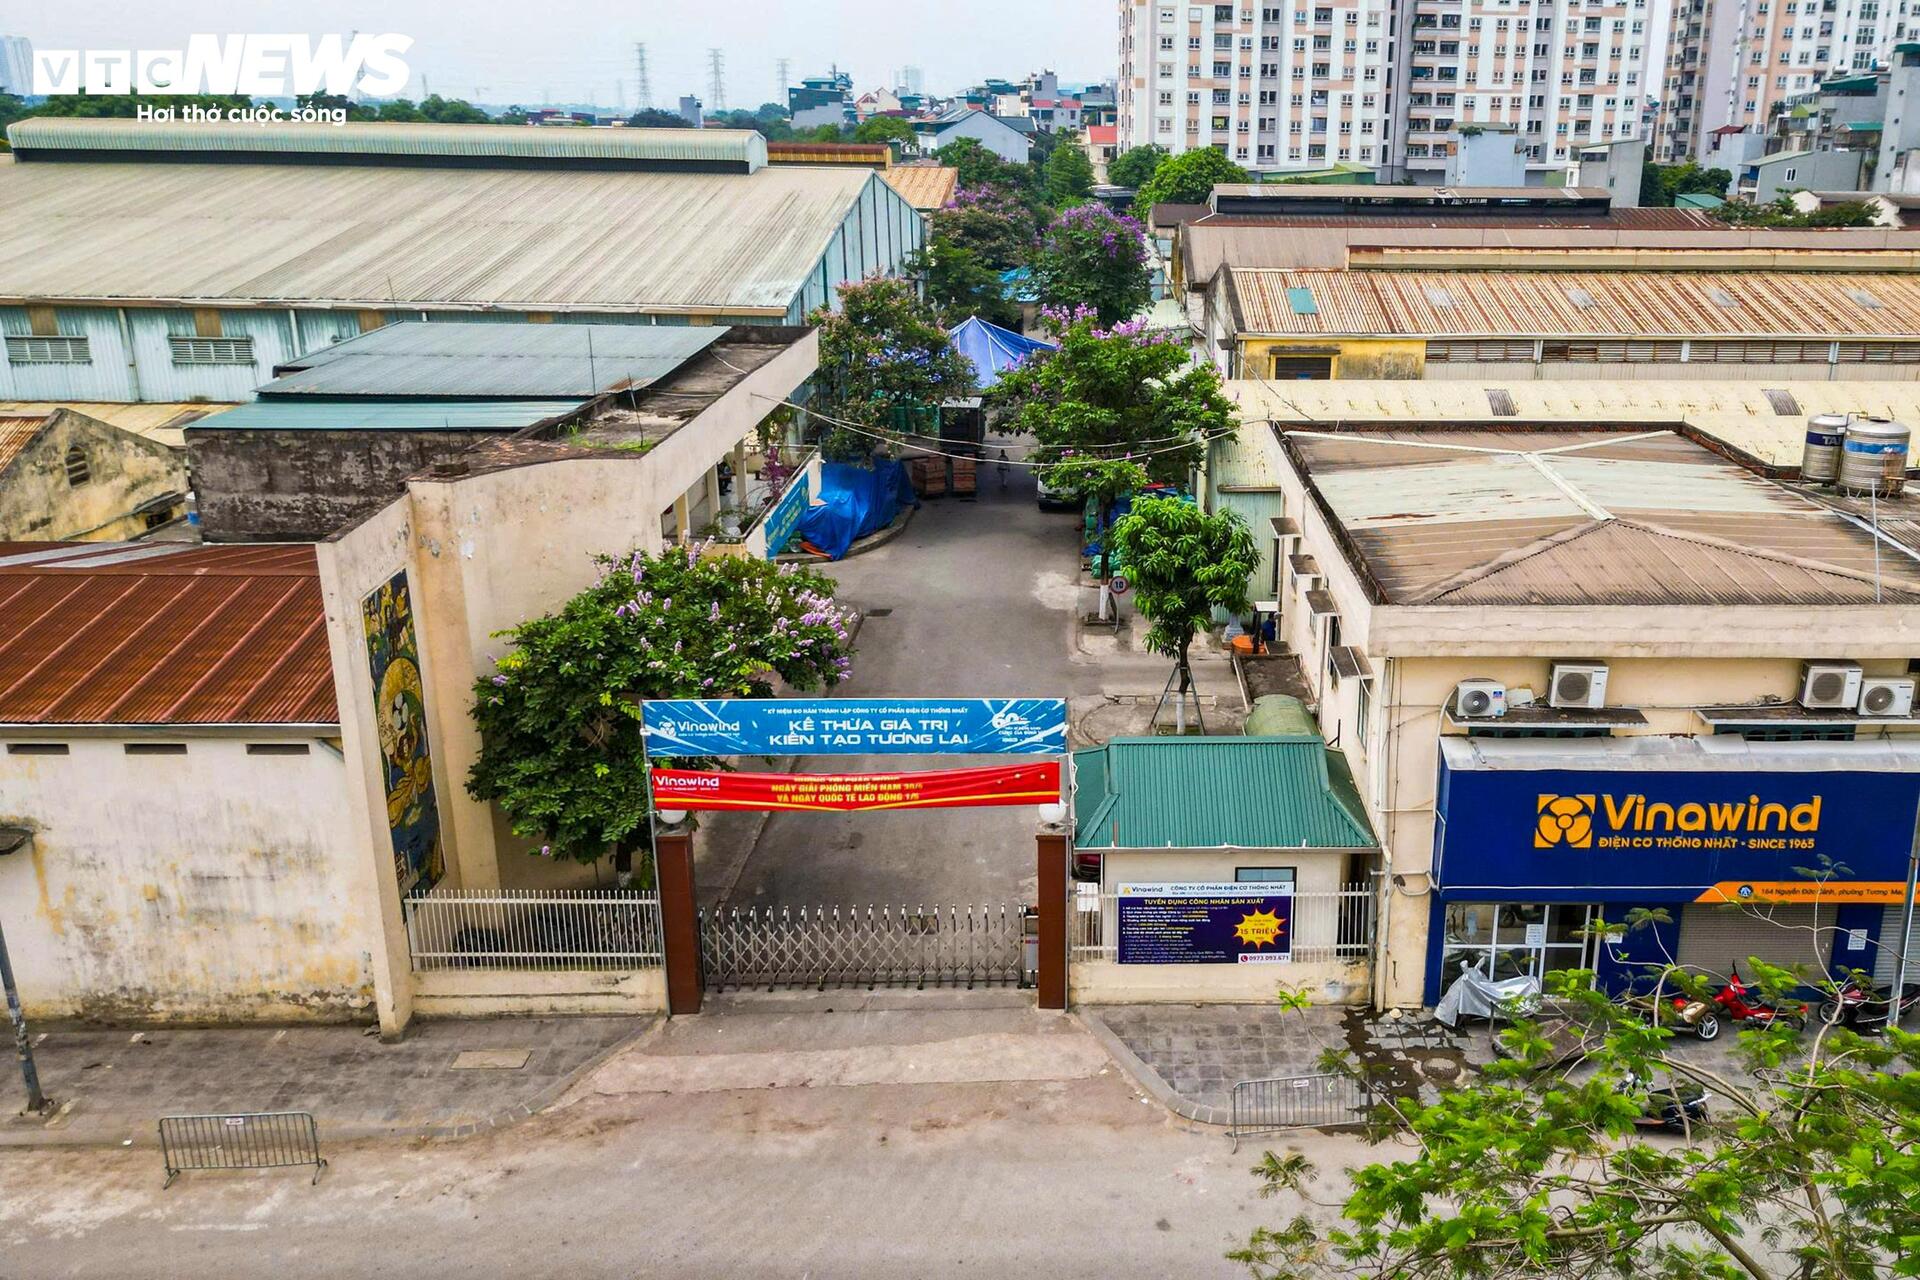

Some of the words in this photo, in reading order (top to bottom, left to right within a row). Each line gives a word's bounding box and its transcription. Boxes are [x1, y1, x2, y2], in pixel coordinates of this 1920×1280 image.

[1115, 581, 1124, 589] 10
[677, 721, 740, 732] Vinawind
[880, 717, 913, 731] GIÁ
[918, 719, 948, 733] TRỊ
[820, 733, 861, 747] TẠO
[867, 731, 933, 745] TƯƠNG
[938, 734, 968, 745] LAI
[655, 776, 719, 787] Vinawind
[820, 783, 851, 792] PHÓNG
[858, 793, 875, 802] LAO
[1601, 794, 1822, 832] Vinawind
[1598, 835, 1630, 850] ĐIỆN
[1632, 836, 1653, 849] CƠ
[1656, 835, 1702, 849] THỐNG
[1703, 836, 1738, 849] NHẤT
[1748, 837, 1786, 849] SINCE
[1789, 837, 1815, 849] 1965
